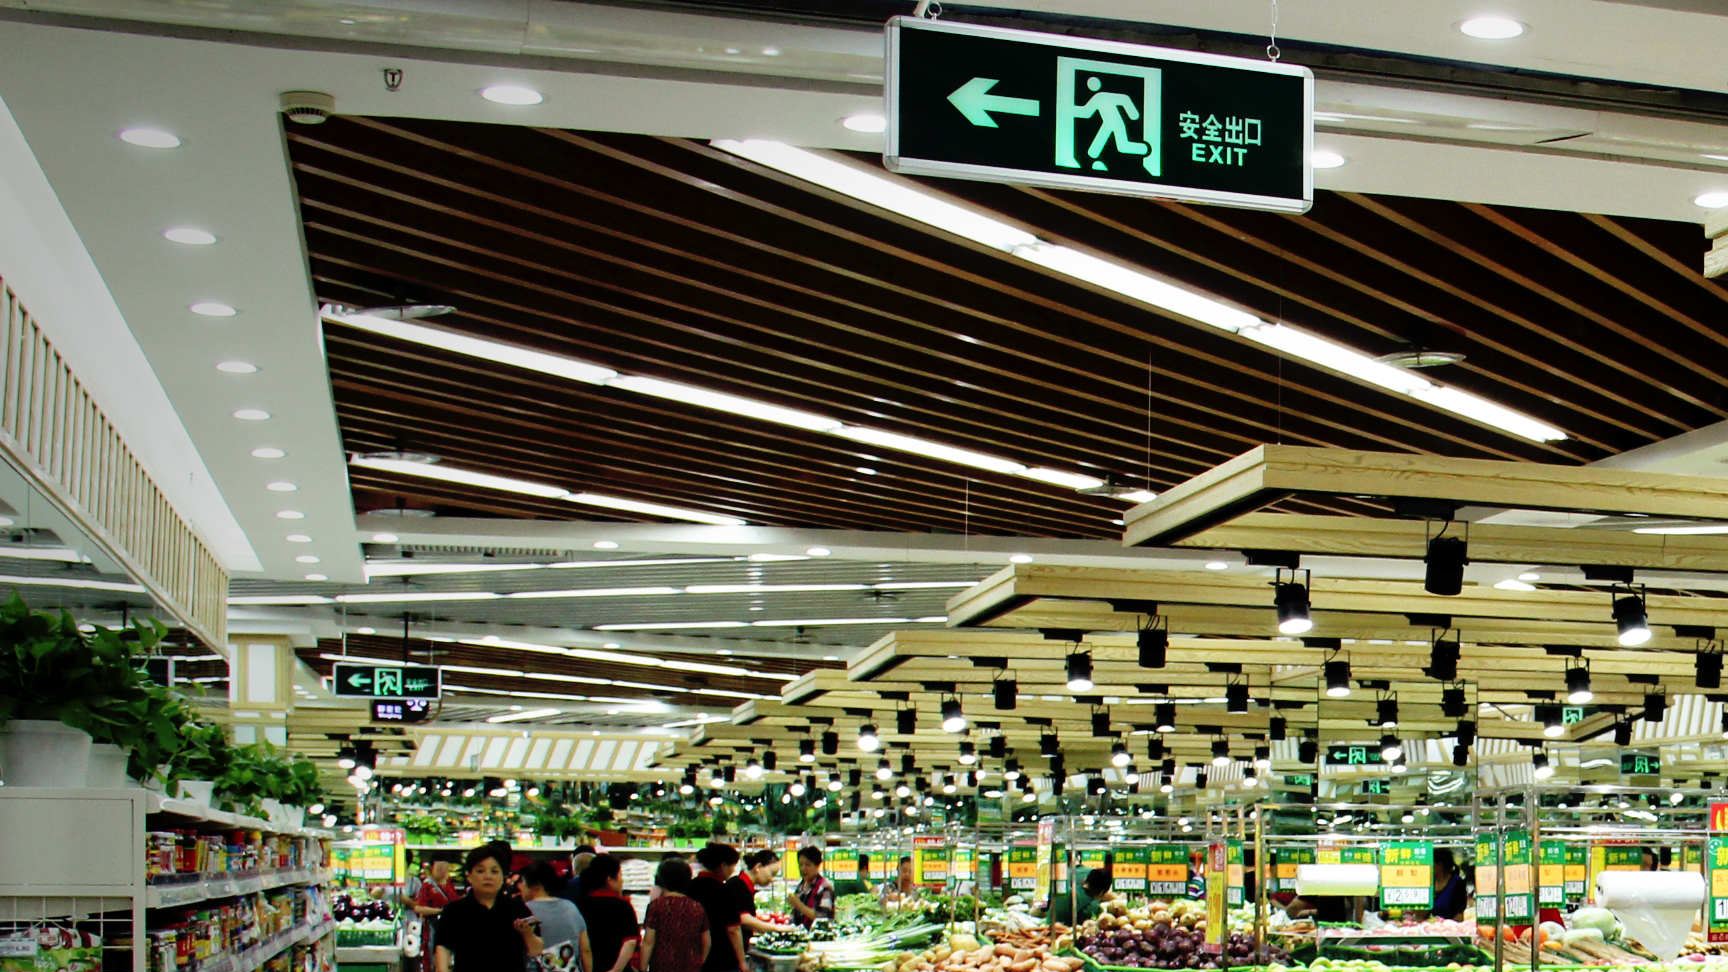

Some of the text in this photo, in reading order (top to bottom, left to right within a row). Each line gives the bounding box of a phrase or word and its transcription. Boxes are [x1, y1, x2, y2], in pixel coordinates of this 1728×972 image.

[1179, 110, 1262, 146] 安全出口
[1191, 143, 1248, 166] EXIT
[1385, 848, 1412, 864] 新鲜
